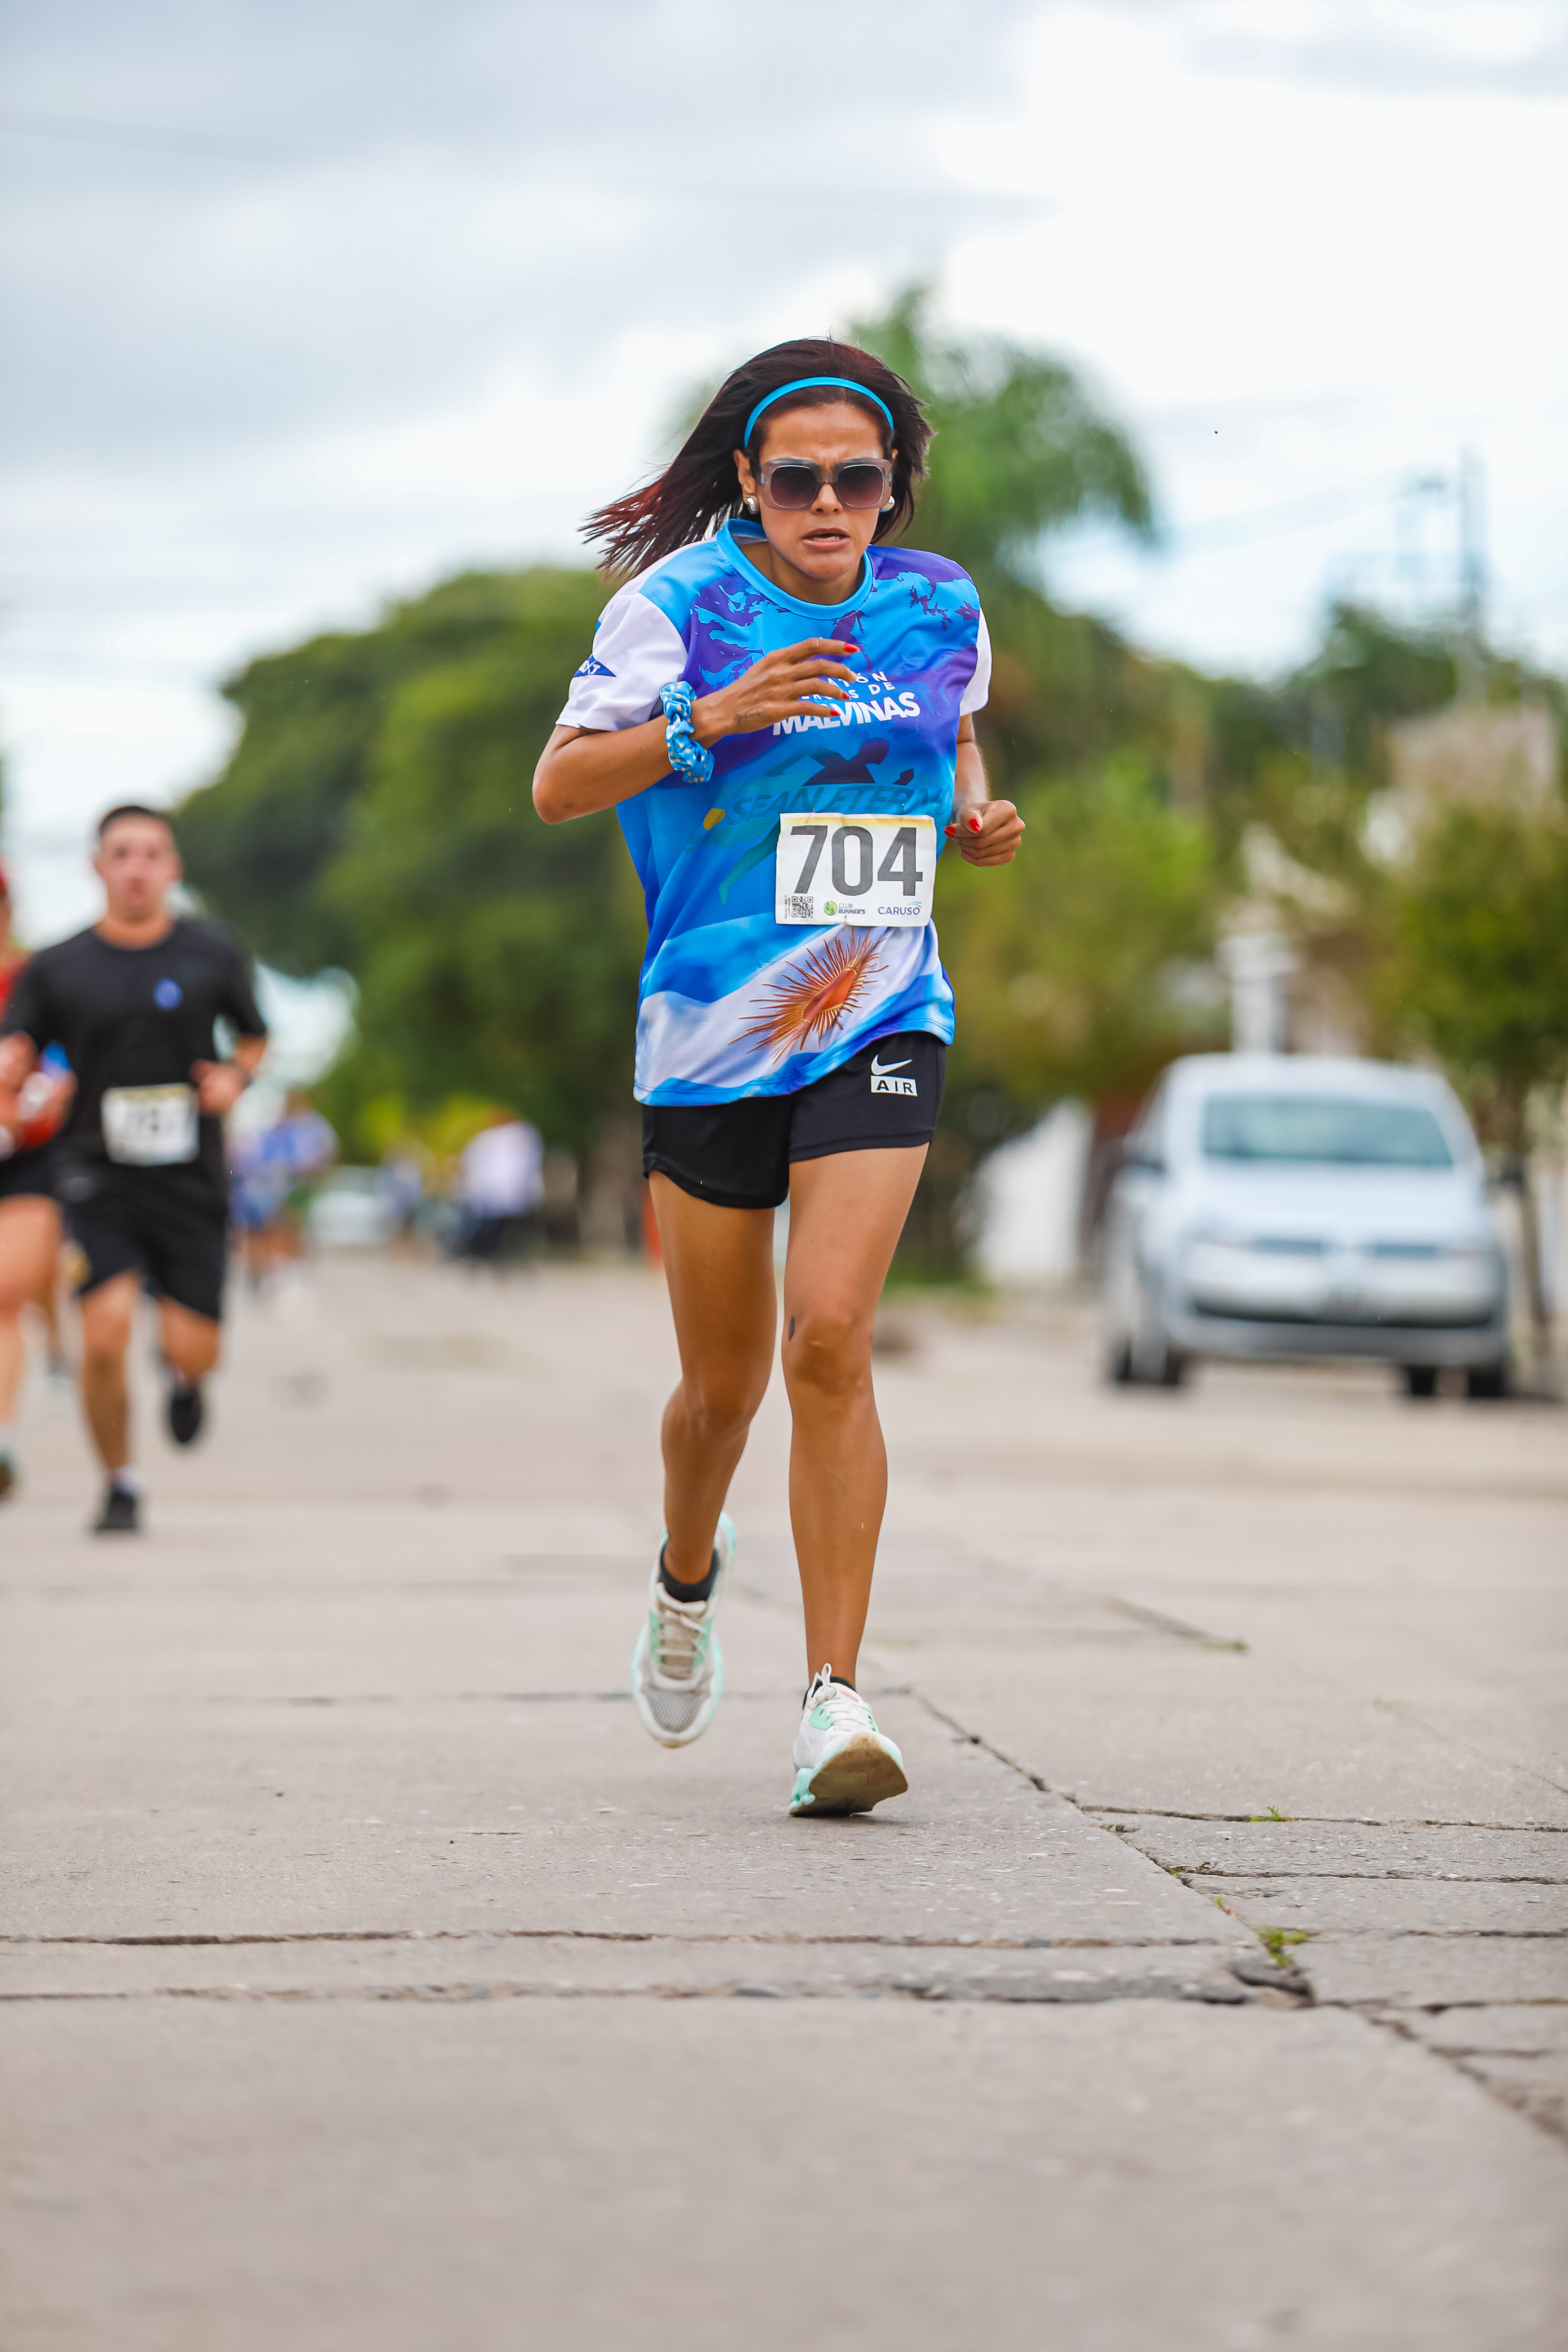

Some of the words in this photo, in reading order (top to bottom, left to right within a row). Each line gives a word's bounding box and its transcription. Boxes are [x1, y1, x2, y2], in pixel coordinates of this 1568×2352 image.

[867, 681, 895, 695] DE
[790, 825, 923, 896] 704
[877, 906, 920, 915] CARUSO
[876, 1079, 914, 1094] AIR
